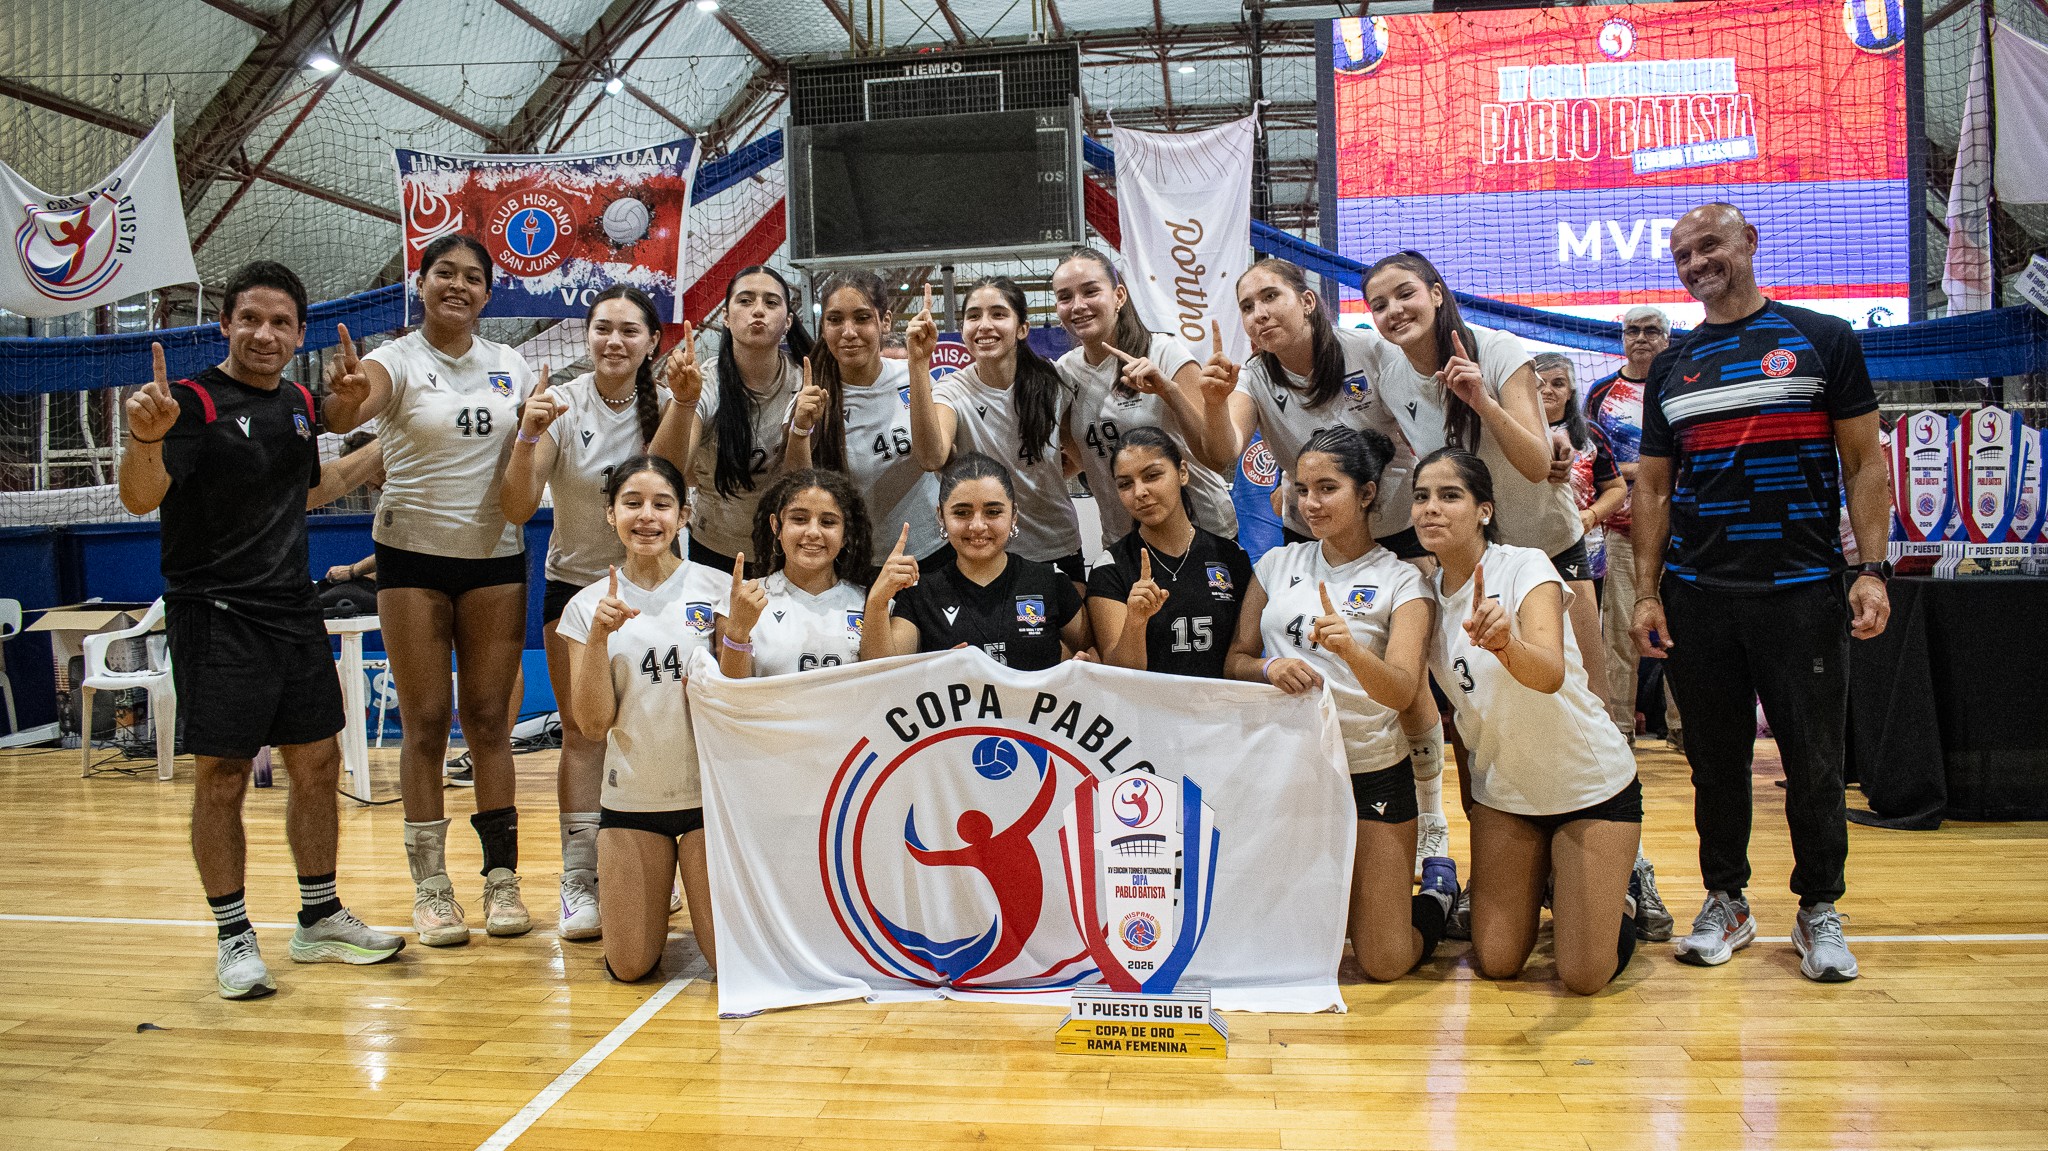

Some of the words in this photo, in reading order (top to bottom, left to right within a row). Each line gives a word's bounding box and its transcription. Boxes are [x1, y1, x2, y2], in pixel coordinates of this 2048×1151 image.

[903, 62, 962, 76] TIEMPO
[1531, 65, 1582, 96] COPA
[1481, 99, 1600, 164] PABLO
[1609, 94, 1757, 158] BATISTA
[117, 195, 137, 254] ATISTA
[491, 199, 519, 235] CLUB
[523, 193, 573, 236] HISPANO
[1558, 219, 1674, 262] MVP
[499, 249, 524, 271] SAN
[526, 250, 561, 272] JUAN
[932, 348, 972, 364] HISP
[455, 406, 493, 437] 48
[873, 426, 911, 462] 46
[1085, 419, 1119, 459] 49
[1245, 443, 1264, 463] CLUB
[1247, 470, 1262, 483] SAN
[1913, 545, 1940, 553] PUESTO
[1975, 547, 2003, 555] PUESTO
[2005, 547, 2019, 555] SUB
[2021, 546, 2028, 554] 16
[1171, 616, 1213, 652] 15
[1285, 613, 1319, 652] 4
[640, 645, 683, 685] 44
[1452, 655, 1476, 694] 3
[885, 683, 1003, 743] COPA
[1028, 691, 1156, 774] PABL
[1132, 874, 1148, 886] COPA
[1115, 886, 1137, 899] PABLO
[1138, 887, 1166, 899] BATISTA
[1124, 911, 1155, 921] HISPANO
[1127, 960, 1154, 970] 2026
[1077, 1002, 1088, 1016] 1°
[1092, 1003, 1148, 1017] PUESTO
[1153, 1005, 1183, 1018] SUB
[1187, 1006, 1203, 1019] 16
[1095, 1025, 1127, 1037] COPA
[1131, 1027, 1146, 1038] DE
[1150, 1027, 1175, 1038] ORO
[1087, 1039, 1122, 1051] RAMA
[1125, 1040, 1188, 1053] FEMENINA
